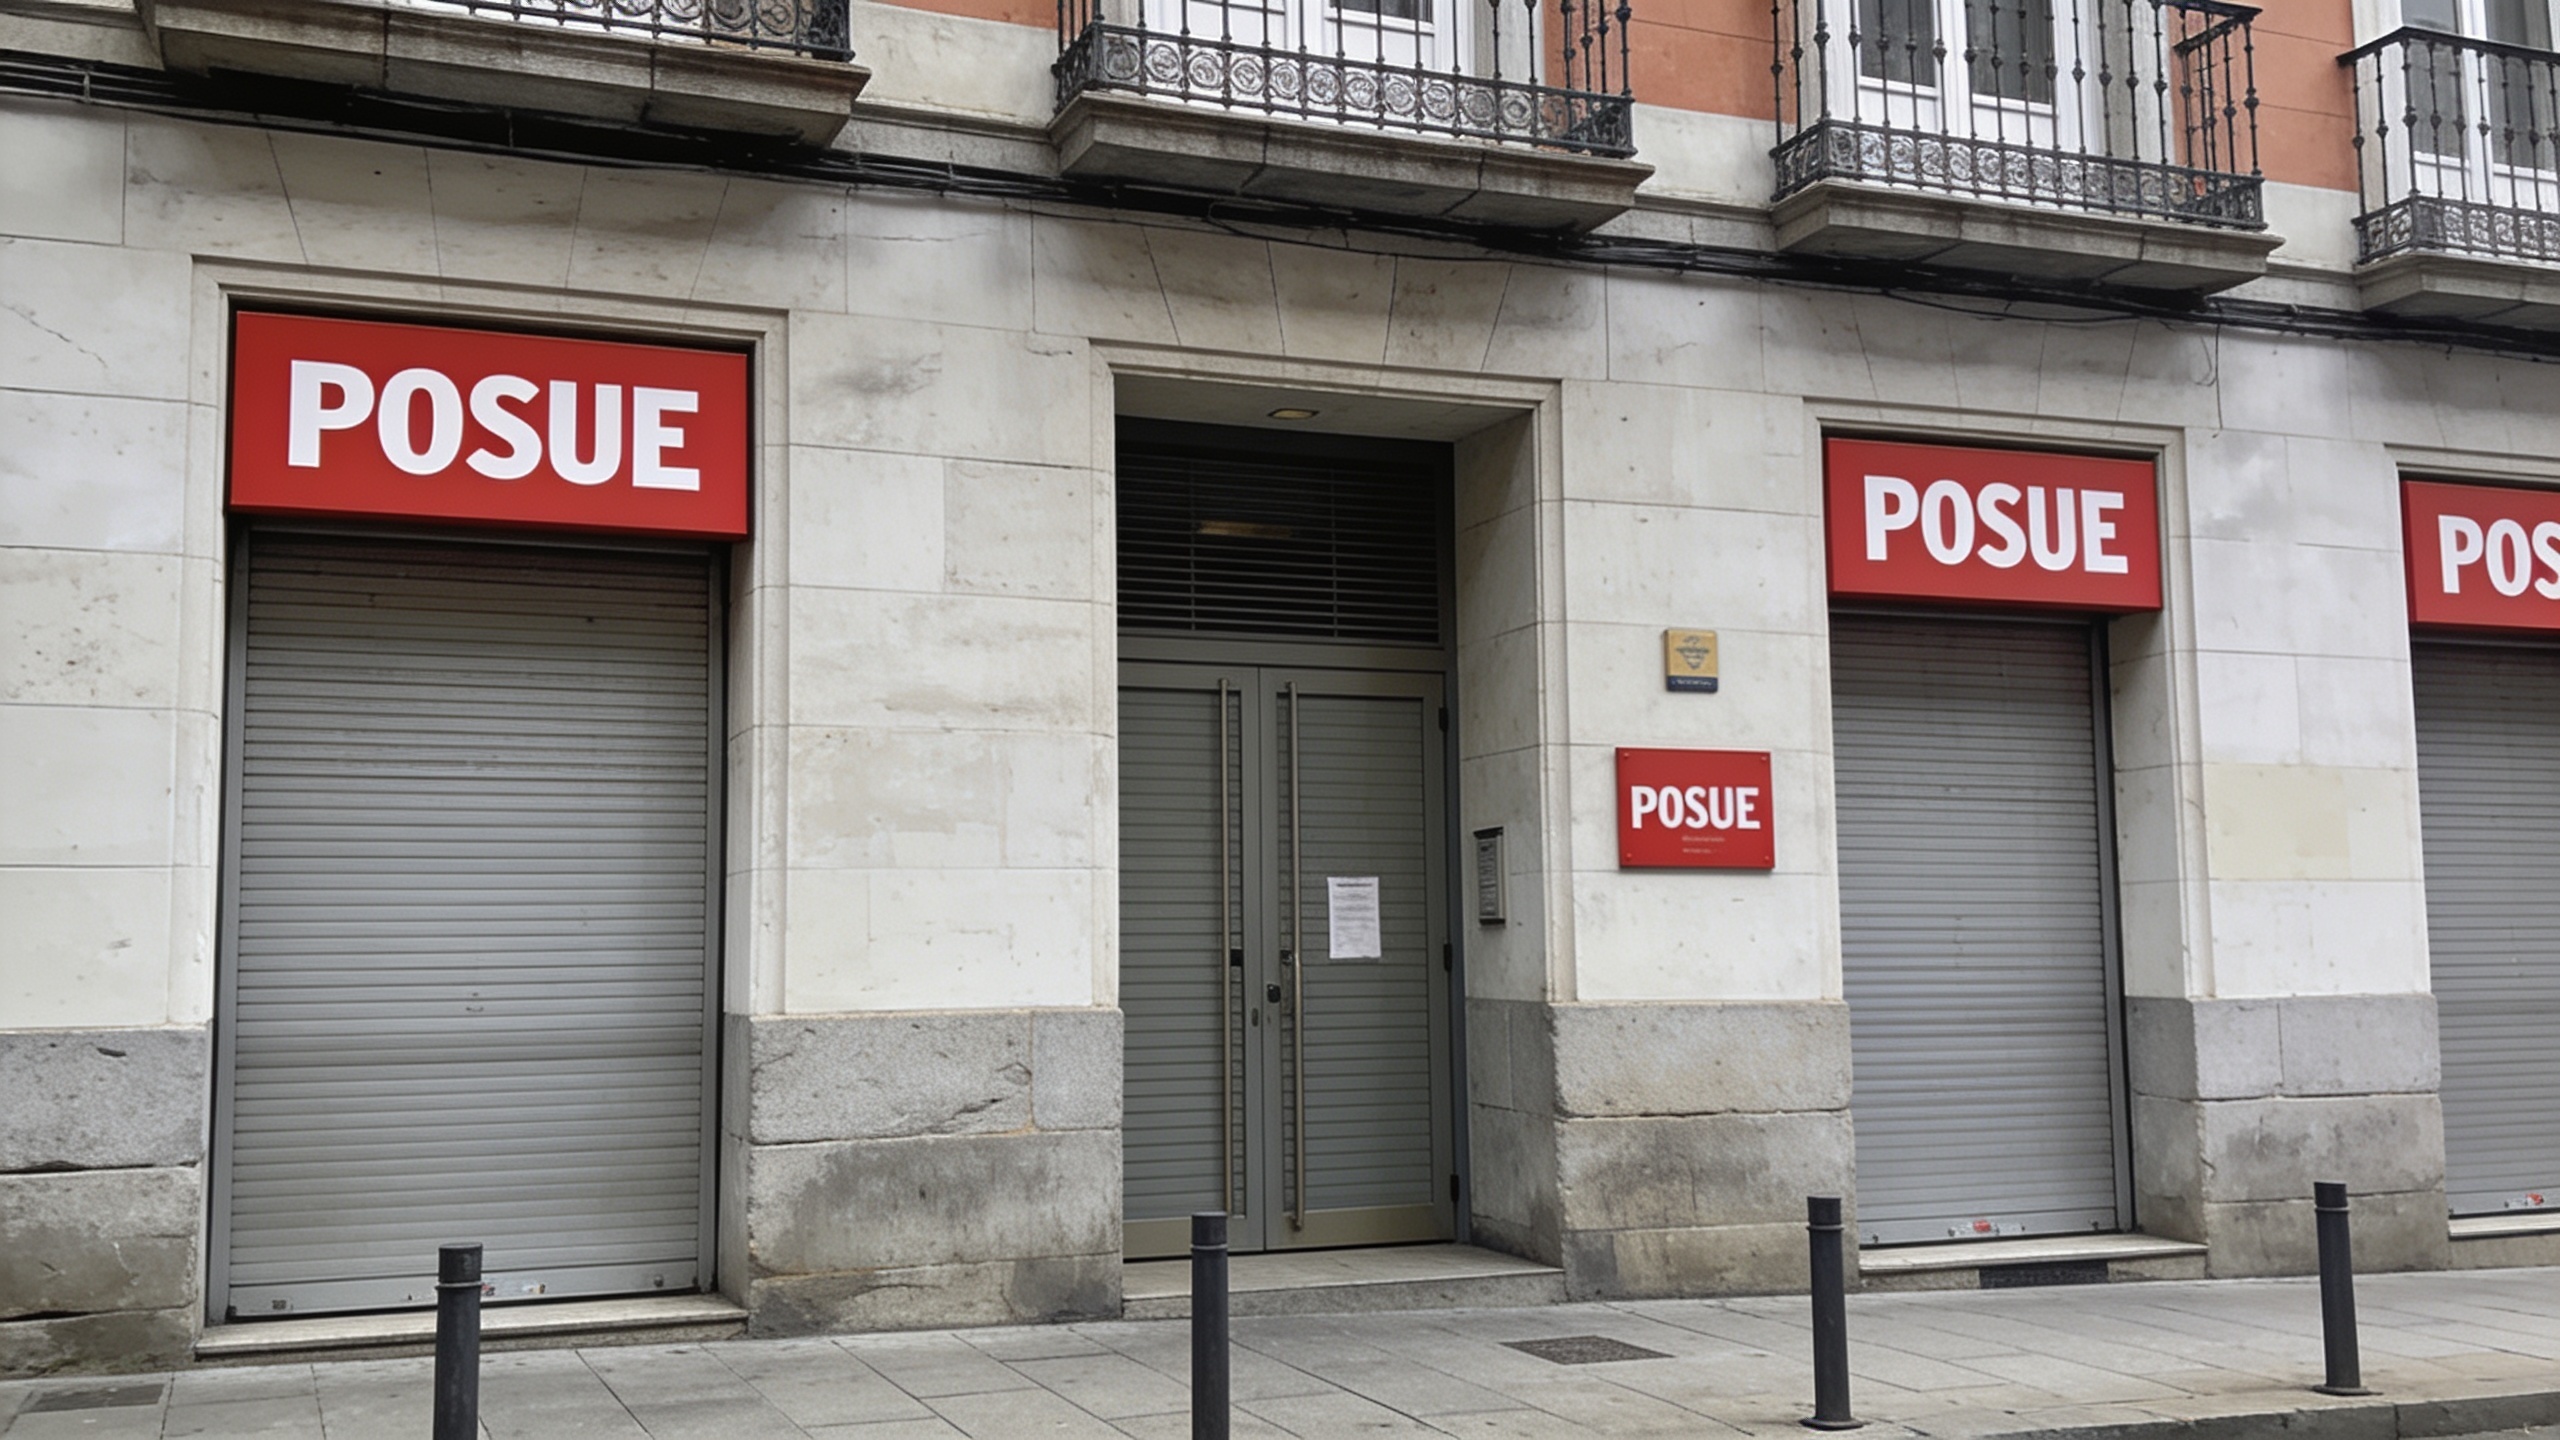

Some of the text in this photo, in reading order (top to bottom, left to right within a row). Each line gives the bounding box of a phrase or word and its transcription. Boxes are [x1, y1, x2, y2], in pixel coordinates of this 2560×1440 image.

[288, 359, 700, 491] POSUE
[1864, 475, 2129, 574] POSUE
[1631, 785, 1761, 830] POSUE
